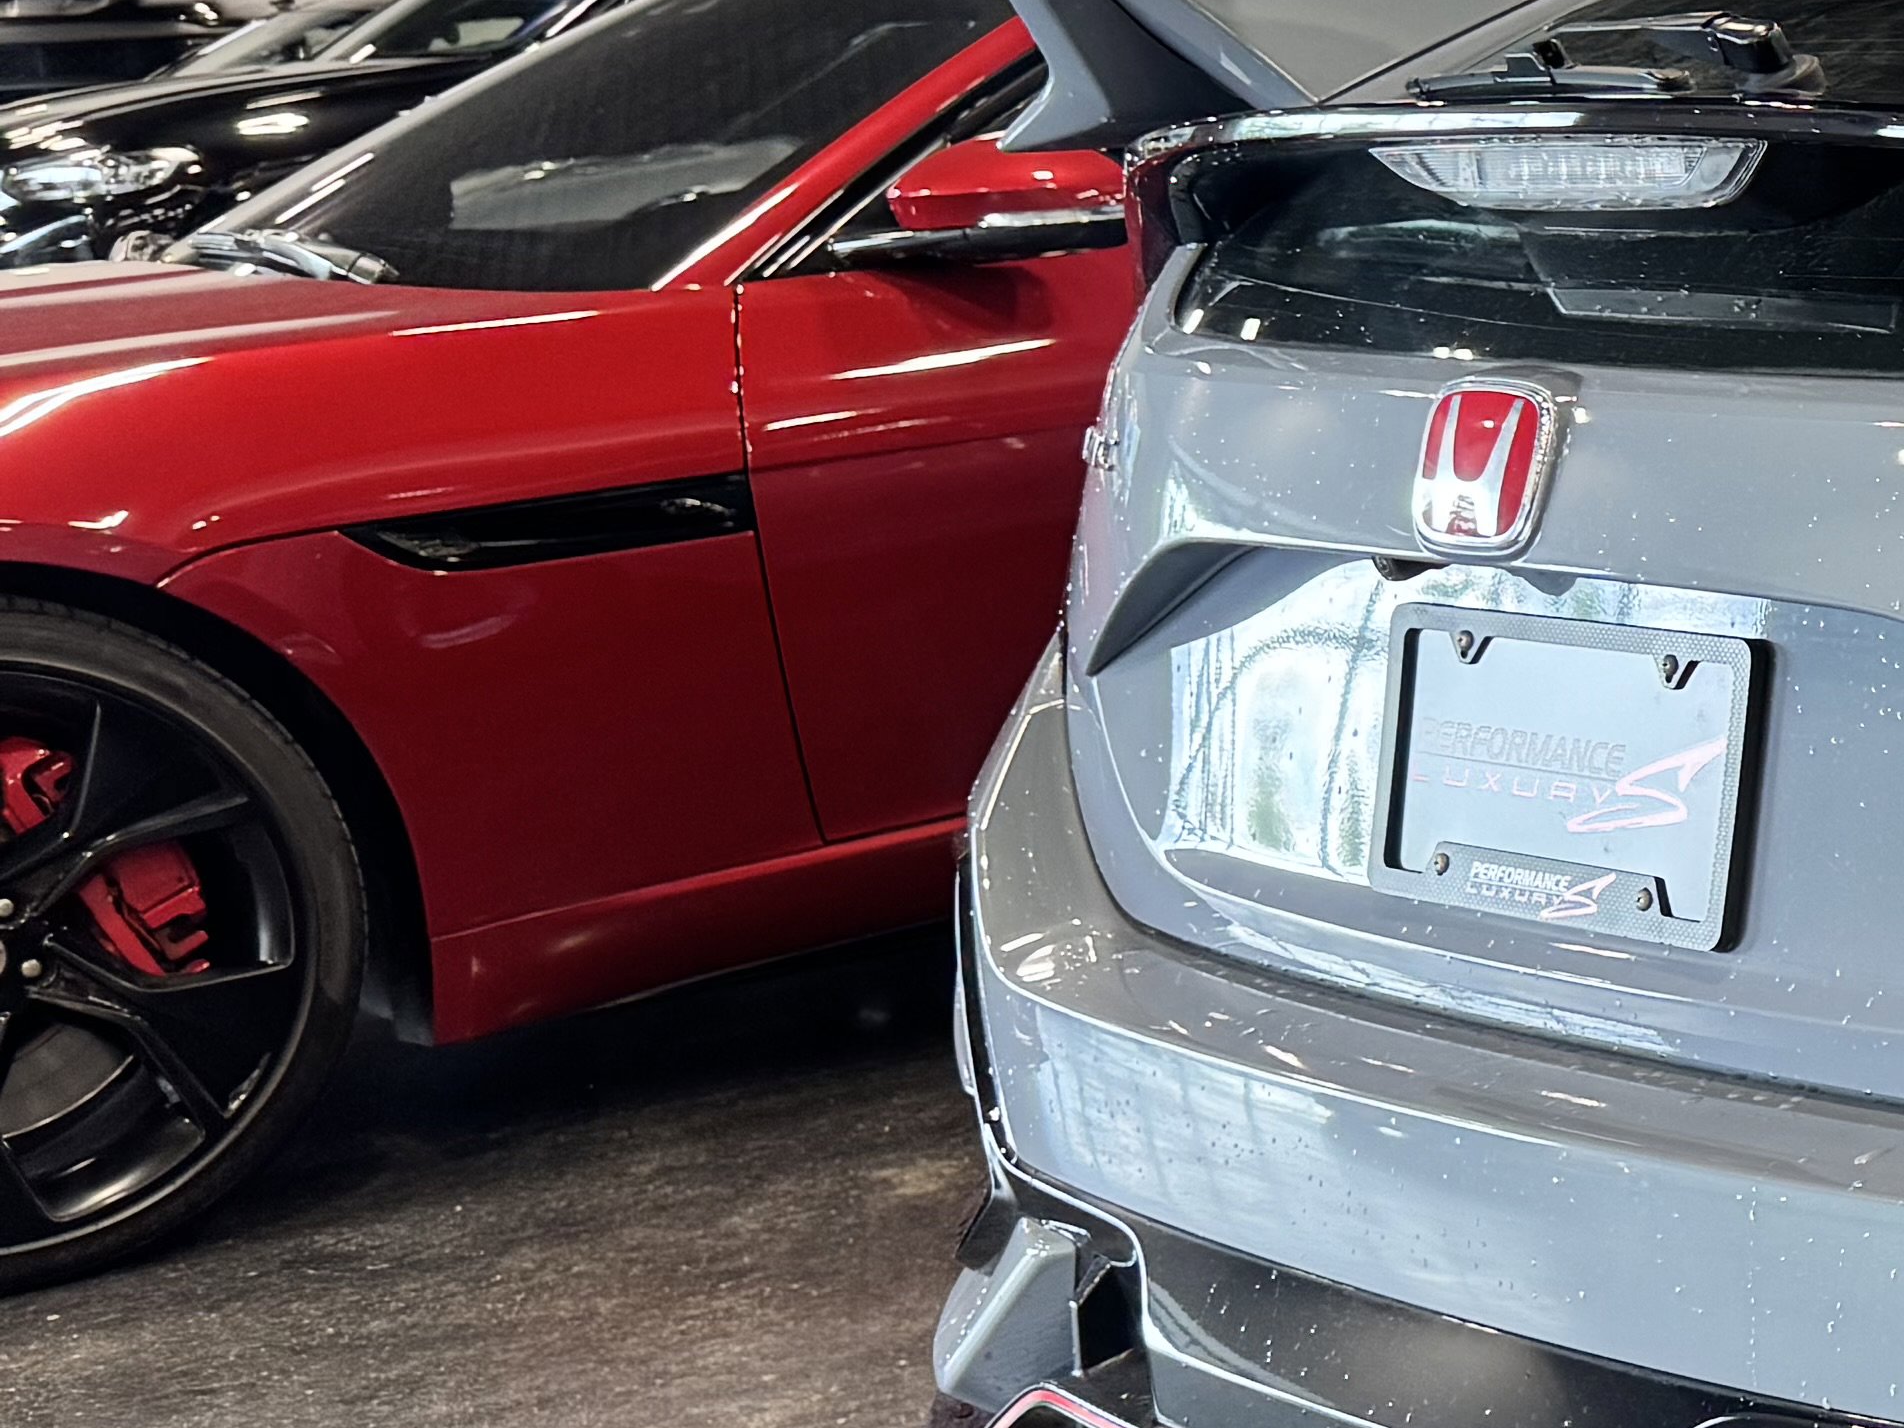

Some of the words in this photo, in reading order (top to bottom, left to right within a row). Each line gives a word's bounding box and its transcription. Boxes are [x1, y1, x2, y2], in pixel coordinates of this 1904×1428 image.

[1420, 717, 1627, 778] PERFORMANCE
[1412, 763, 1612, 806] LUXURY
[1464, 880, 1567, 906] LUXURY
[1470, 861, 1572, 892] PERFORMANCE
